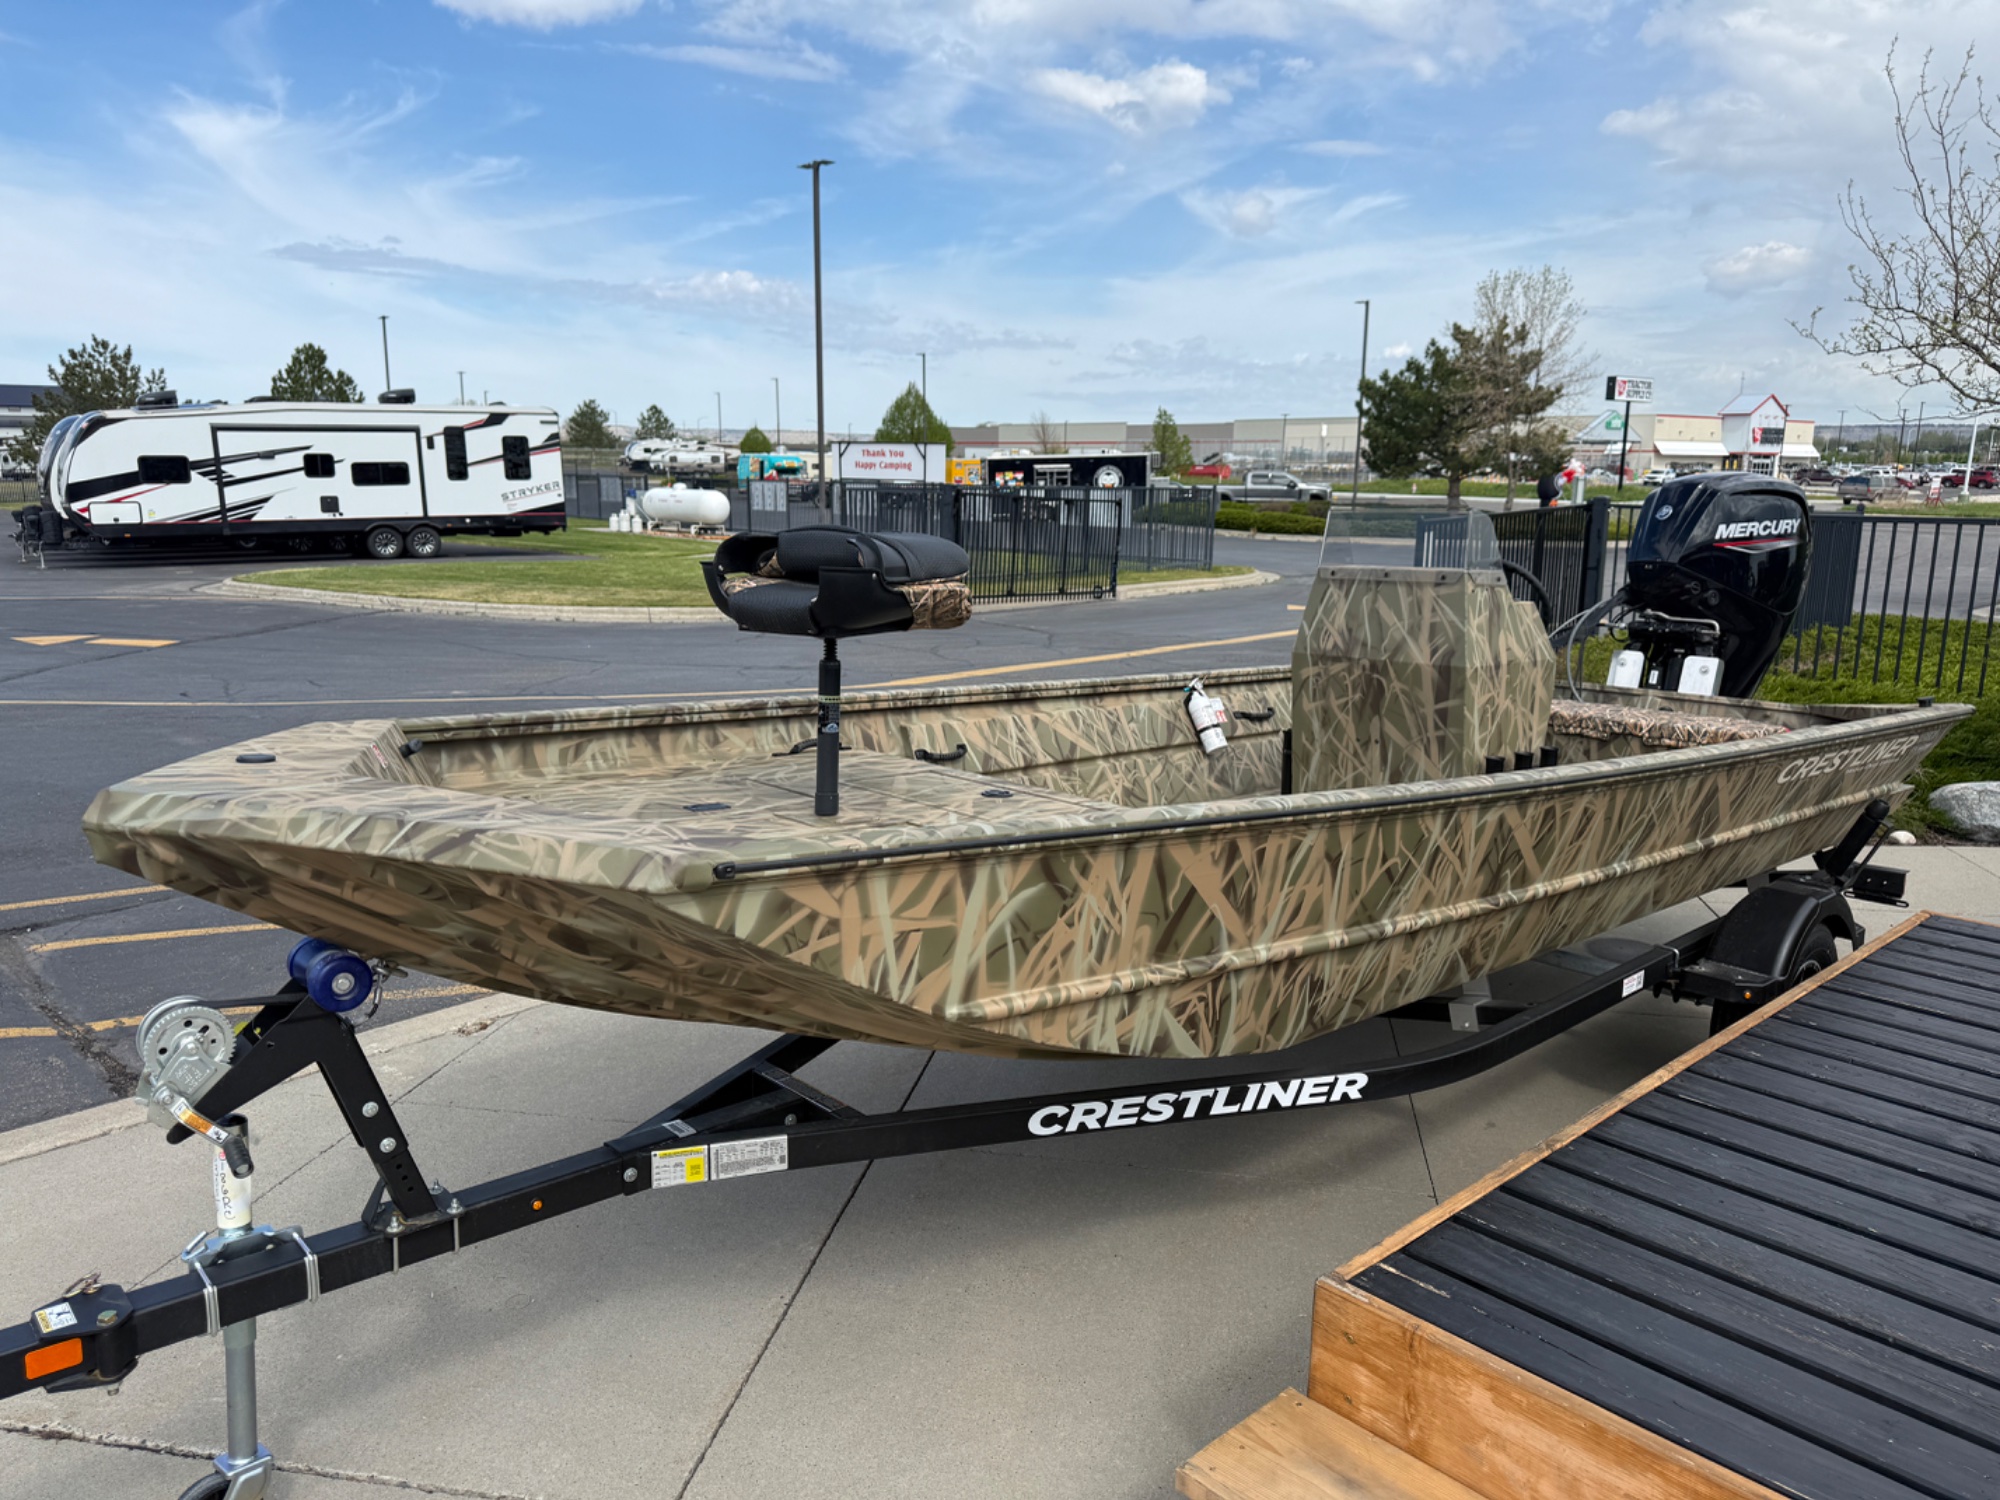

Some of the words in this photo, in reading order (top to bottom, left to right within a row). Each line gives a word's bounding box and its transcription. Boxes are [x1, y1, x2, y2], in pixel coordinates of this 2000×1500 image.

[862, 448, 886, 458] Thank
[889, 448, 905, 458] You
[855, 461, 876, 471] Happy
[879, 461, 912, 472] Camping
[501, 481, 560, 501] STRYKER
[1714, 518, 1801, 540] MERCURY
[1777, 735, 1920, 784] CRESTLINER
[1027, 1072, 1369, 1136] CRESTLINER
